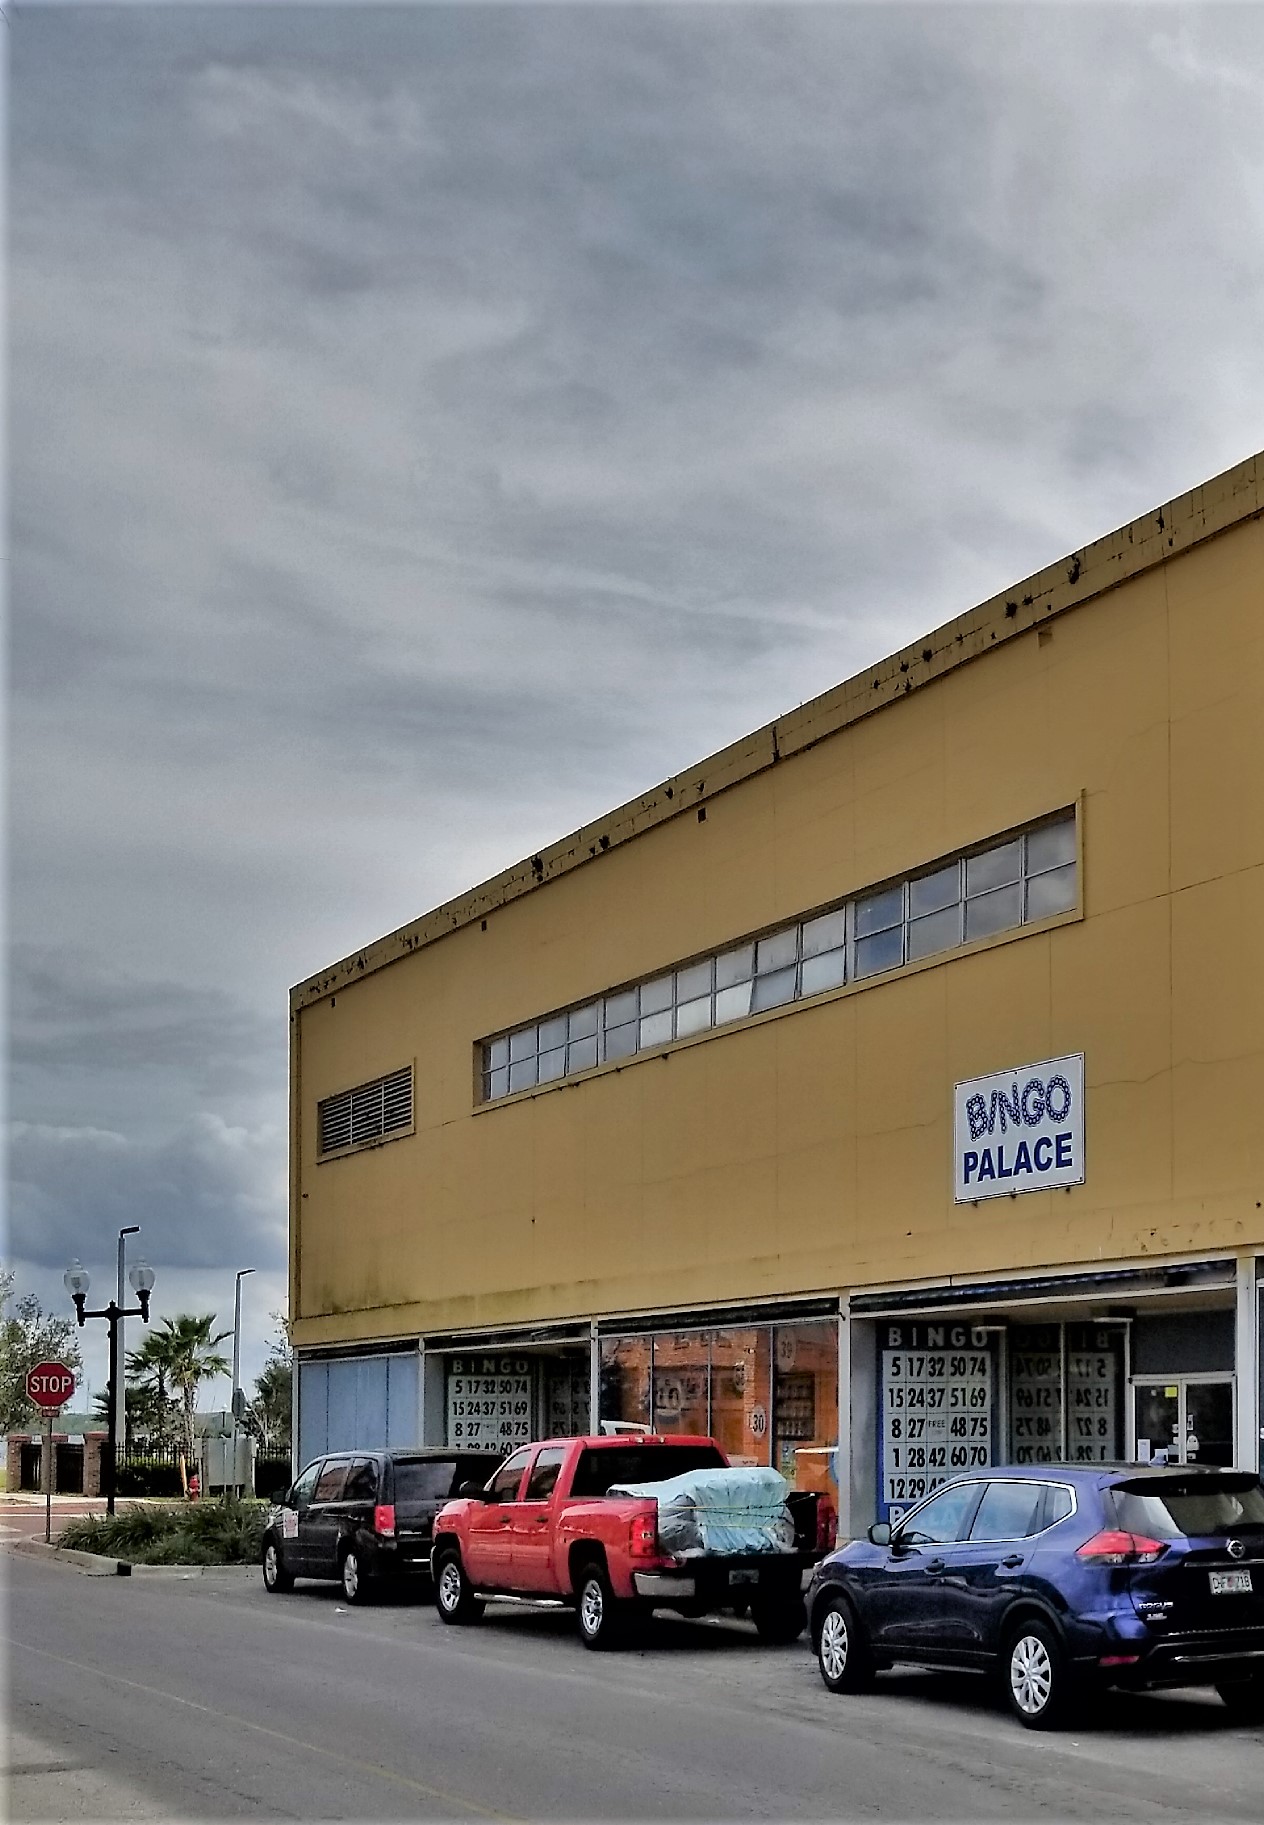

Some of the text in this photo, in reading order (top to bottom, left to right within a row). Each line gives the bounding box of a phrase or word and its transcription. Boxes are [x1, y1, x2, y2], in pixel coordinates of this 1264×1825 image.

[965, 1074, 1072, 1142] BINGO
[963, 1131, 1073, 1185] PALACE
[889, 1327, 989, 1347] BINGO
[453, 1359, 528, 1374] BINGO
[891, 1357, 986, 1377] 5 17 32 50 74
[30, 1375, 72, 1393] STOP
[455, 1380, 527, 1394] 5 17 32 50 74
[453, 1401, 527, 1415] 15 24 37 51 69
[889, 1388, 986, 1408] 15 24 37 51 69
[455, 1422, 463, 1436] 8
[467, 1422, 480, 1436] 27
[500, 1422, 512, 1436] 48
[514, 1422, 528, 1436] 75
[891, 1418, 902, 1438] 8
[908, 1418, 925, 1438] 27
[950, 1417, 967, 1437] 48
[970, 1417, 987, 1437] 75
[893, 1447, 987, 1467] 1 28 42 60 70
[890, 1478, 905, 1499] 12
[908, 1478, 926, 1499] 29
